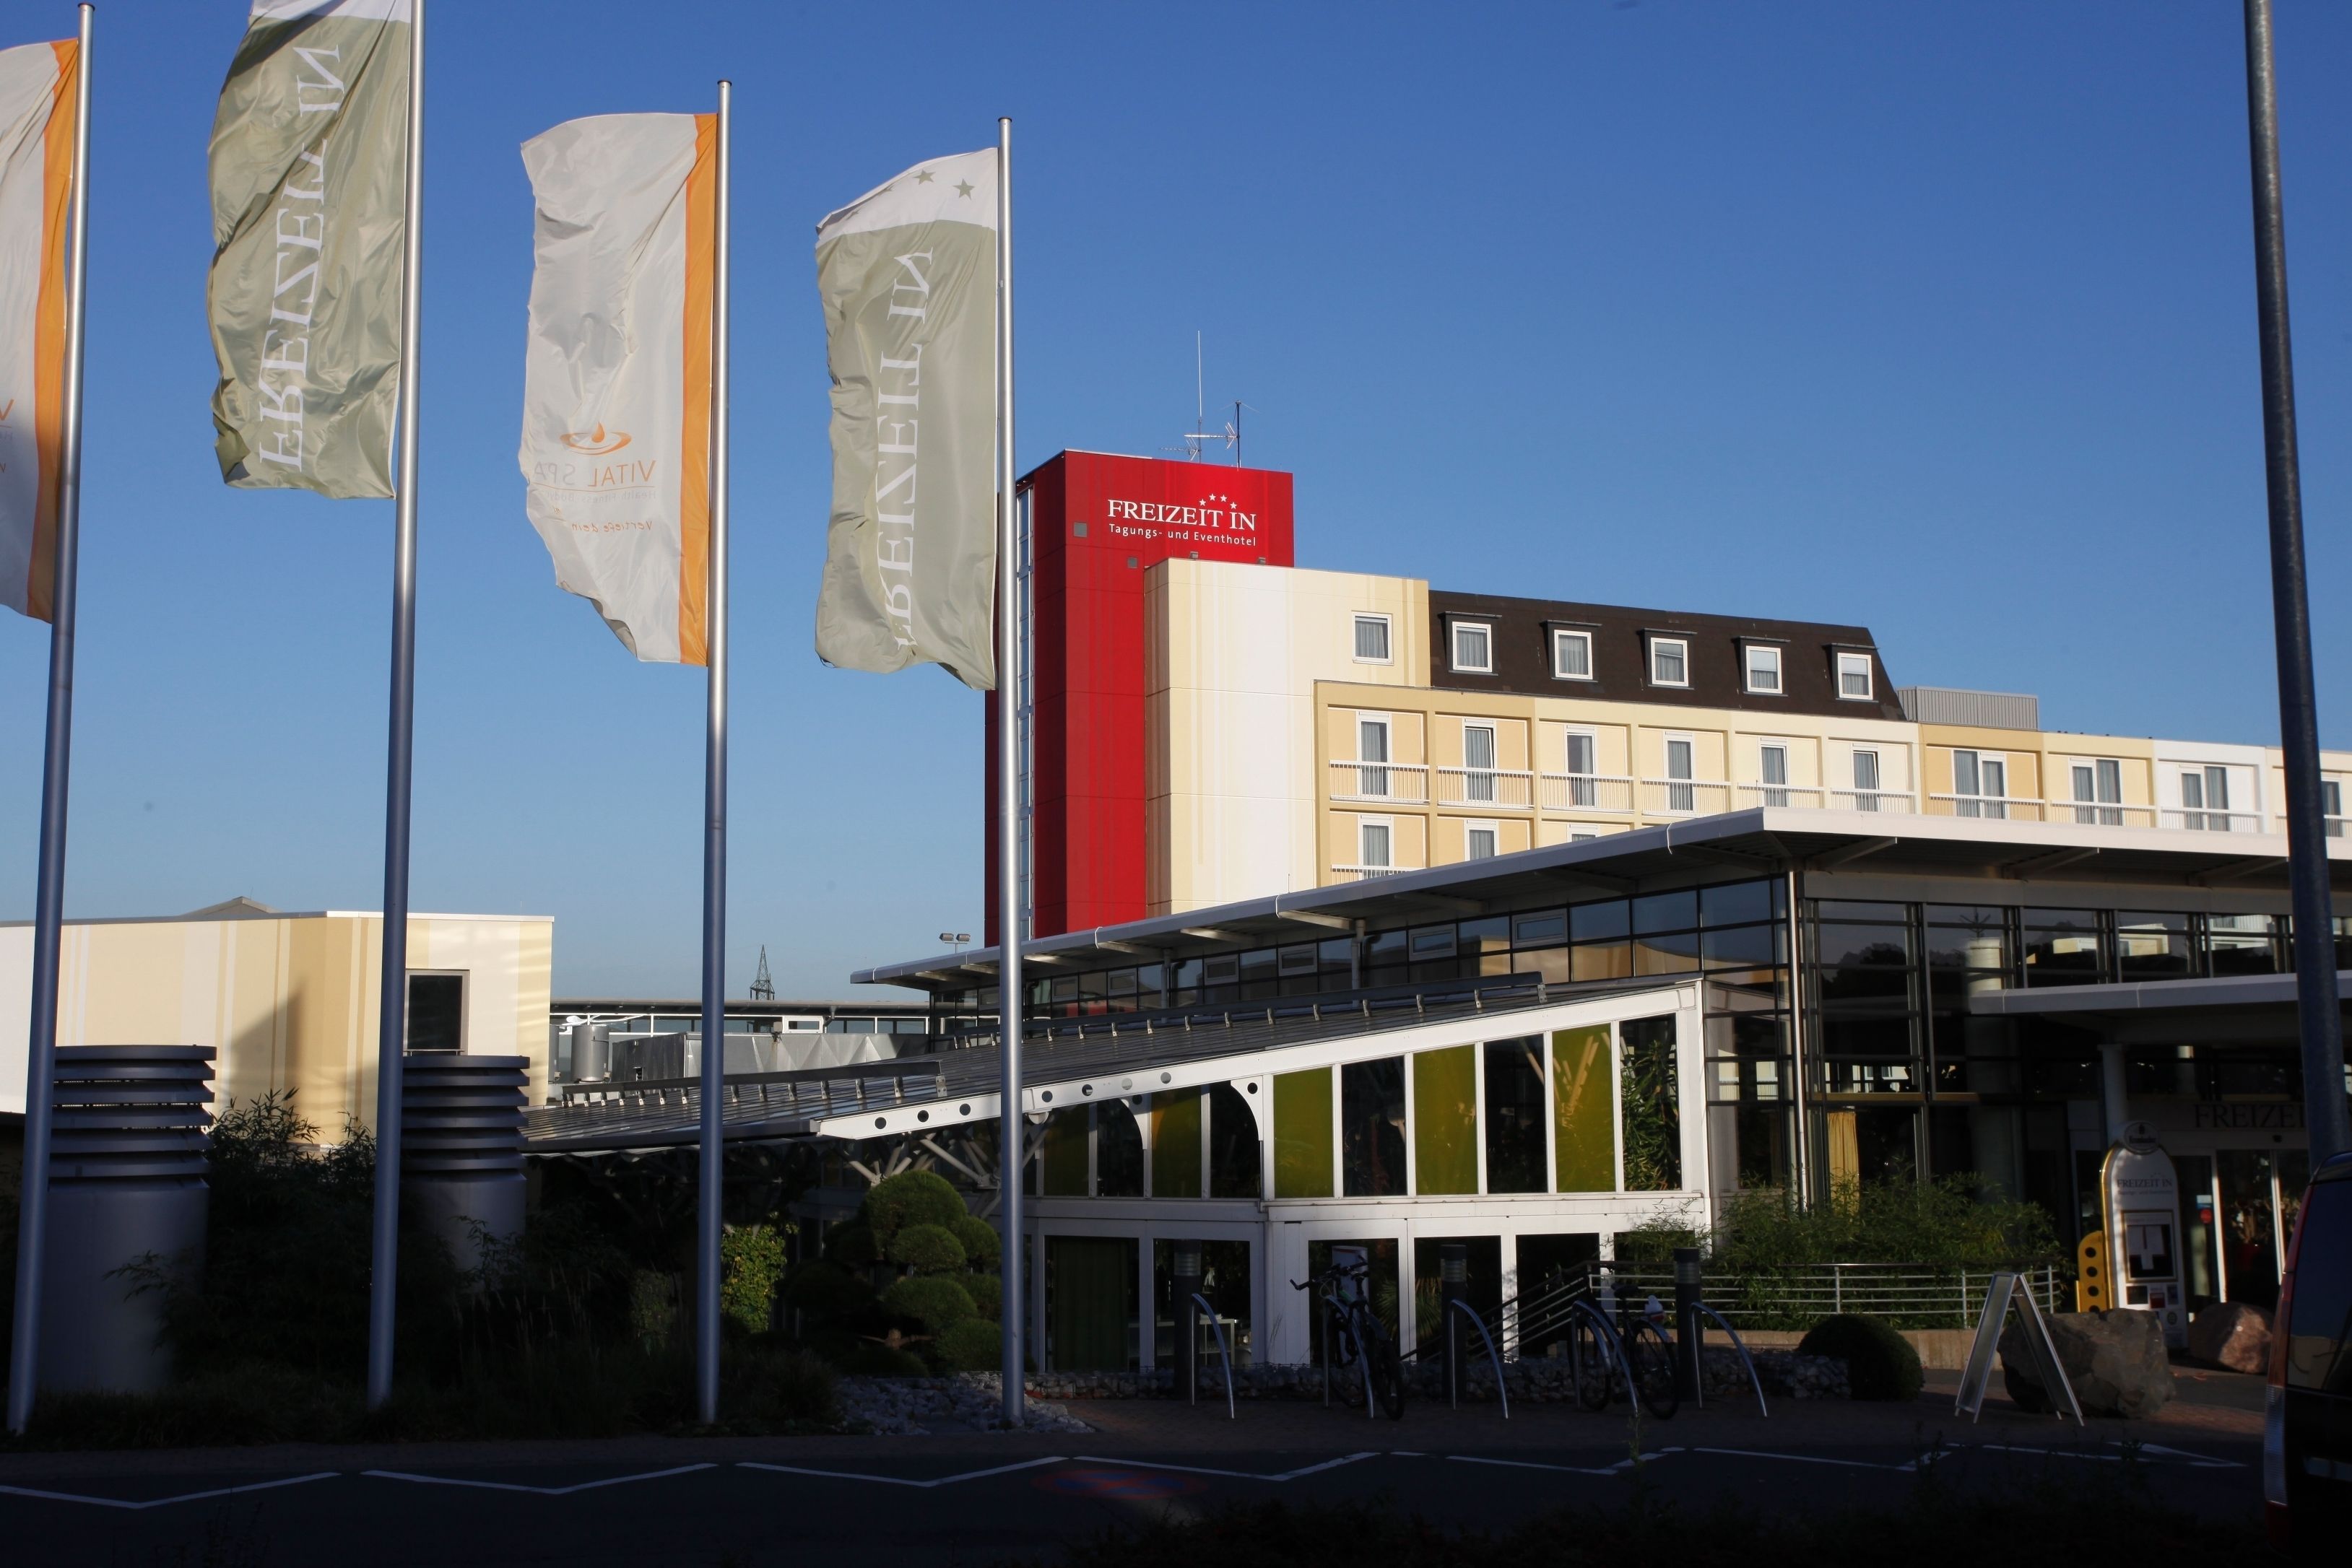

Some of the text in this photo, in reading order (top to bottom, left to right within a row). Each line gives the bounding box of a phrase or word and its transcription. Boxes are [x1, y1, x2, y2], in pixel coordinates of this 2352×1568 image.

[1107, 499, 1257, 531] FREIZEIT IN
[1108, 523, 1257, 546] Tagungs- und Eventhotel
[2193, 1104, 2306, 1128] FREIZEI
[2117, 1177, 2173, 1188] FREIZEIT IN
